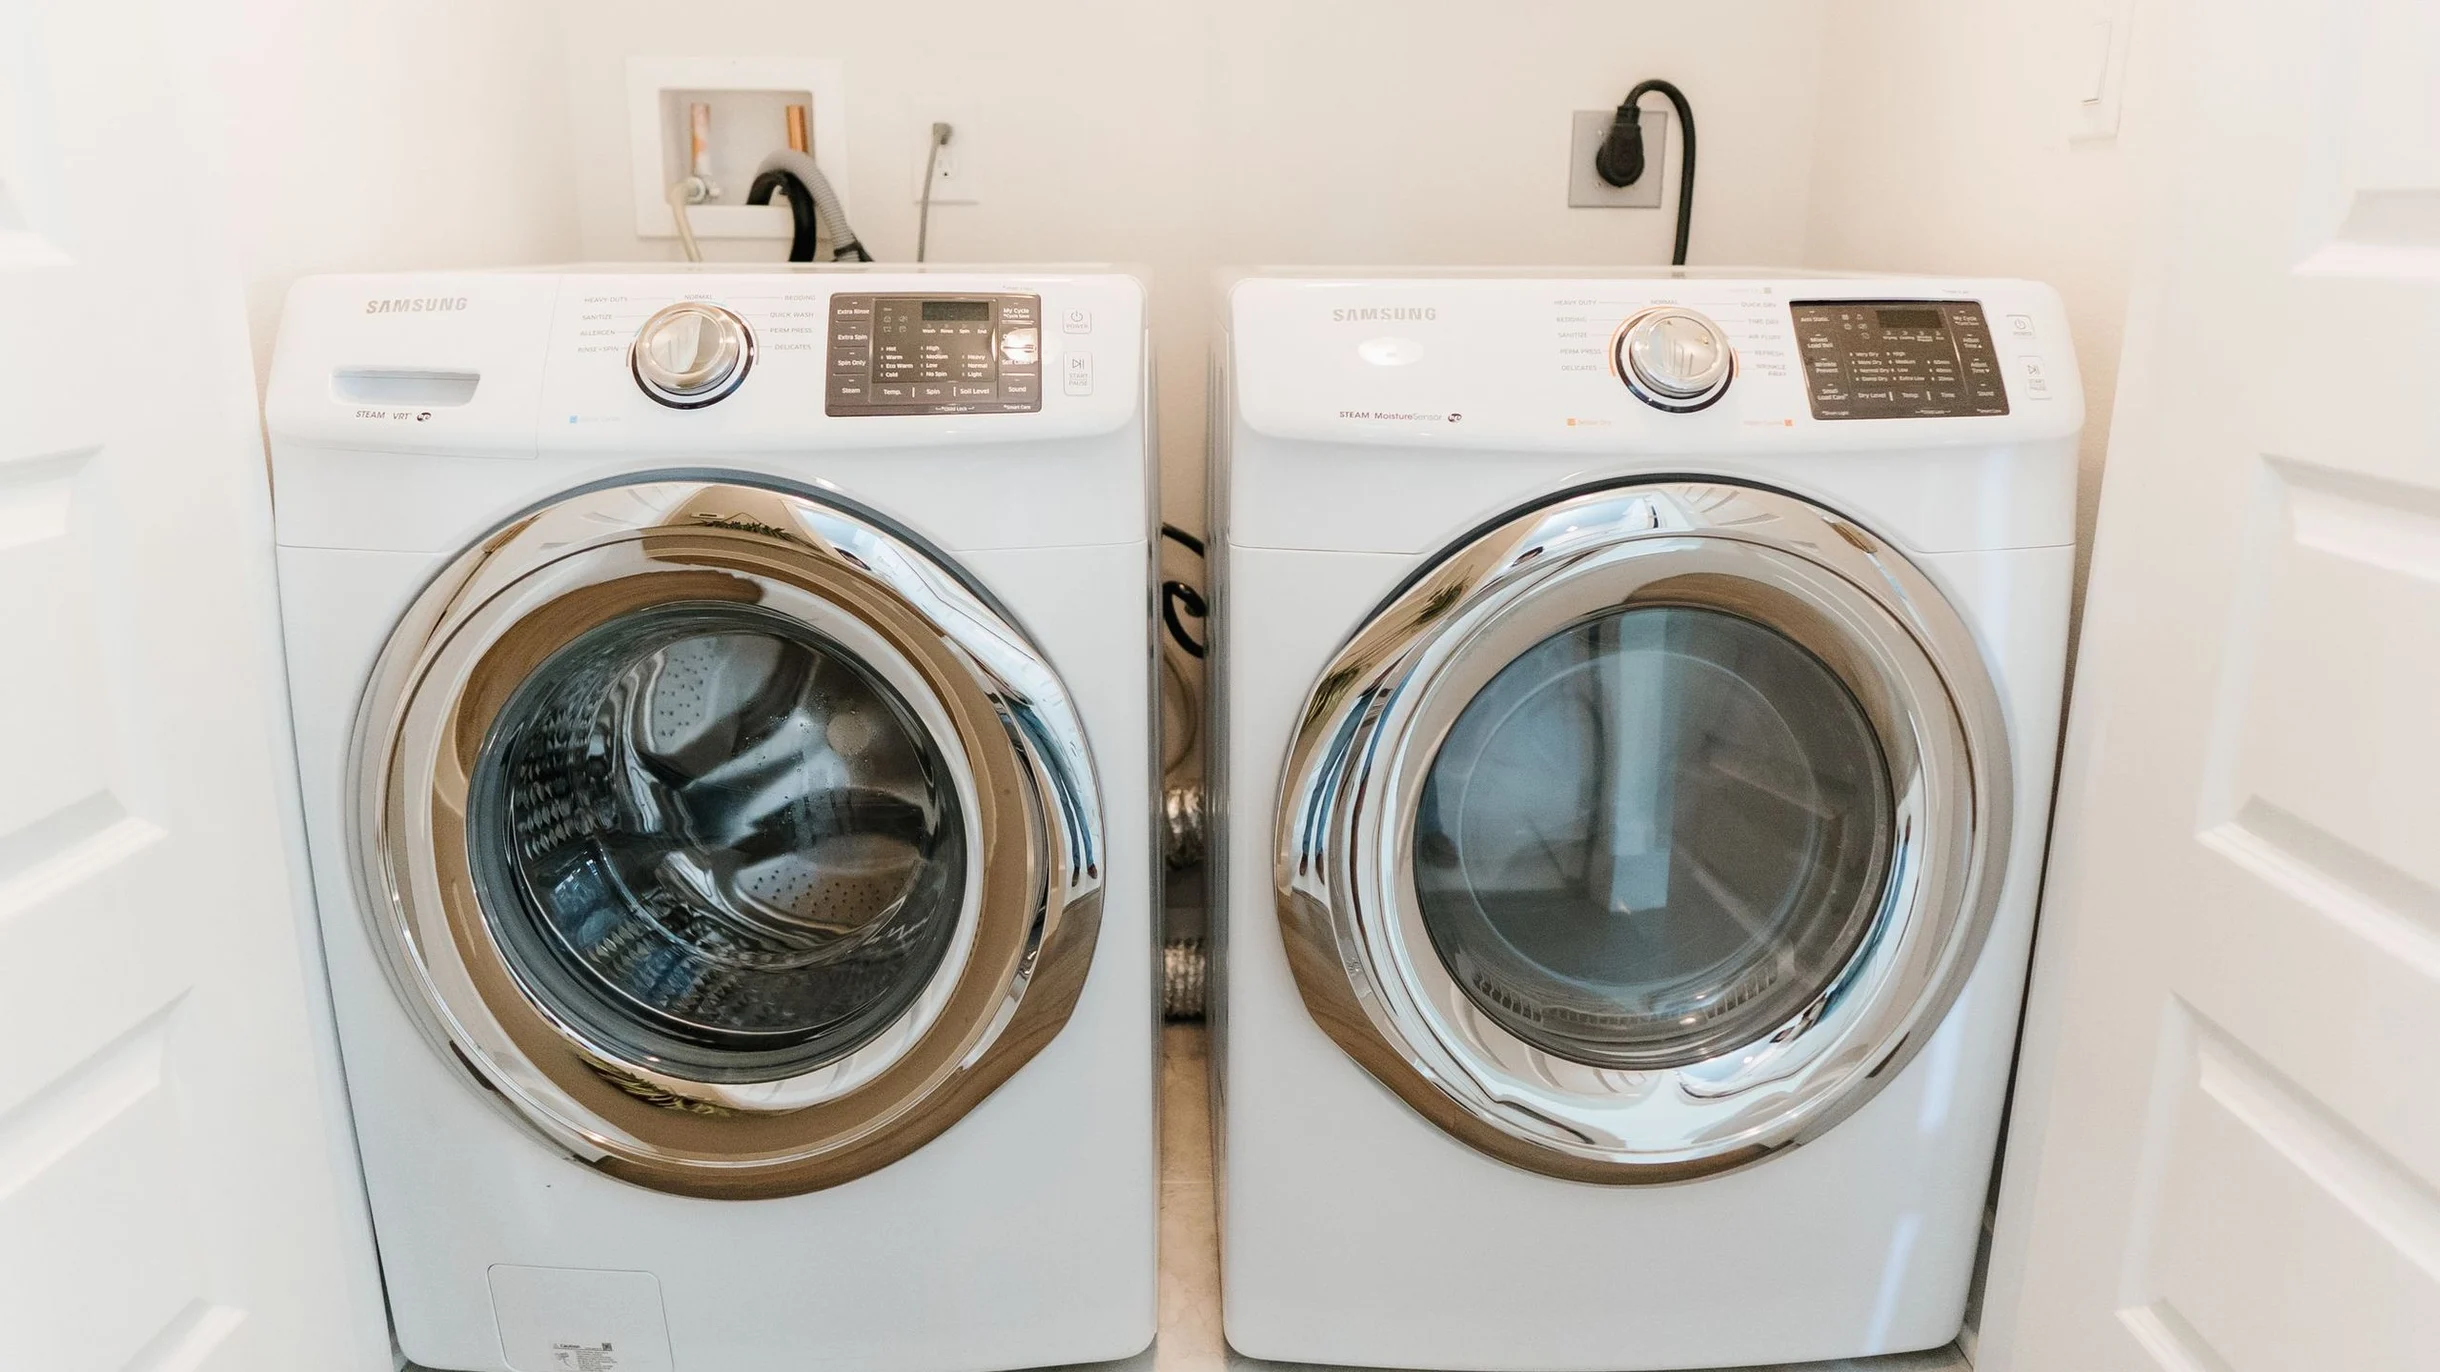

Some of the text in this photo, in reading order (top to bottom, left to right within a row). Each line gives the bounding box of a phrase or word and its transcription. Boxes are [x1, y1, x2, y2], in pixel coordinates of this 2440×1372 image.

[365, 297, 468, 314] SAMSUNG
[1332, 307, 1436, 322] SAMSUNG
[355, 411, 386, 419] STEAM
[1339, 411, 1370, 419] STEAM
